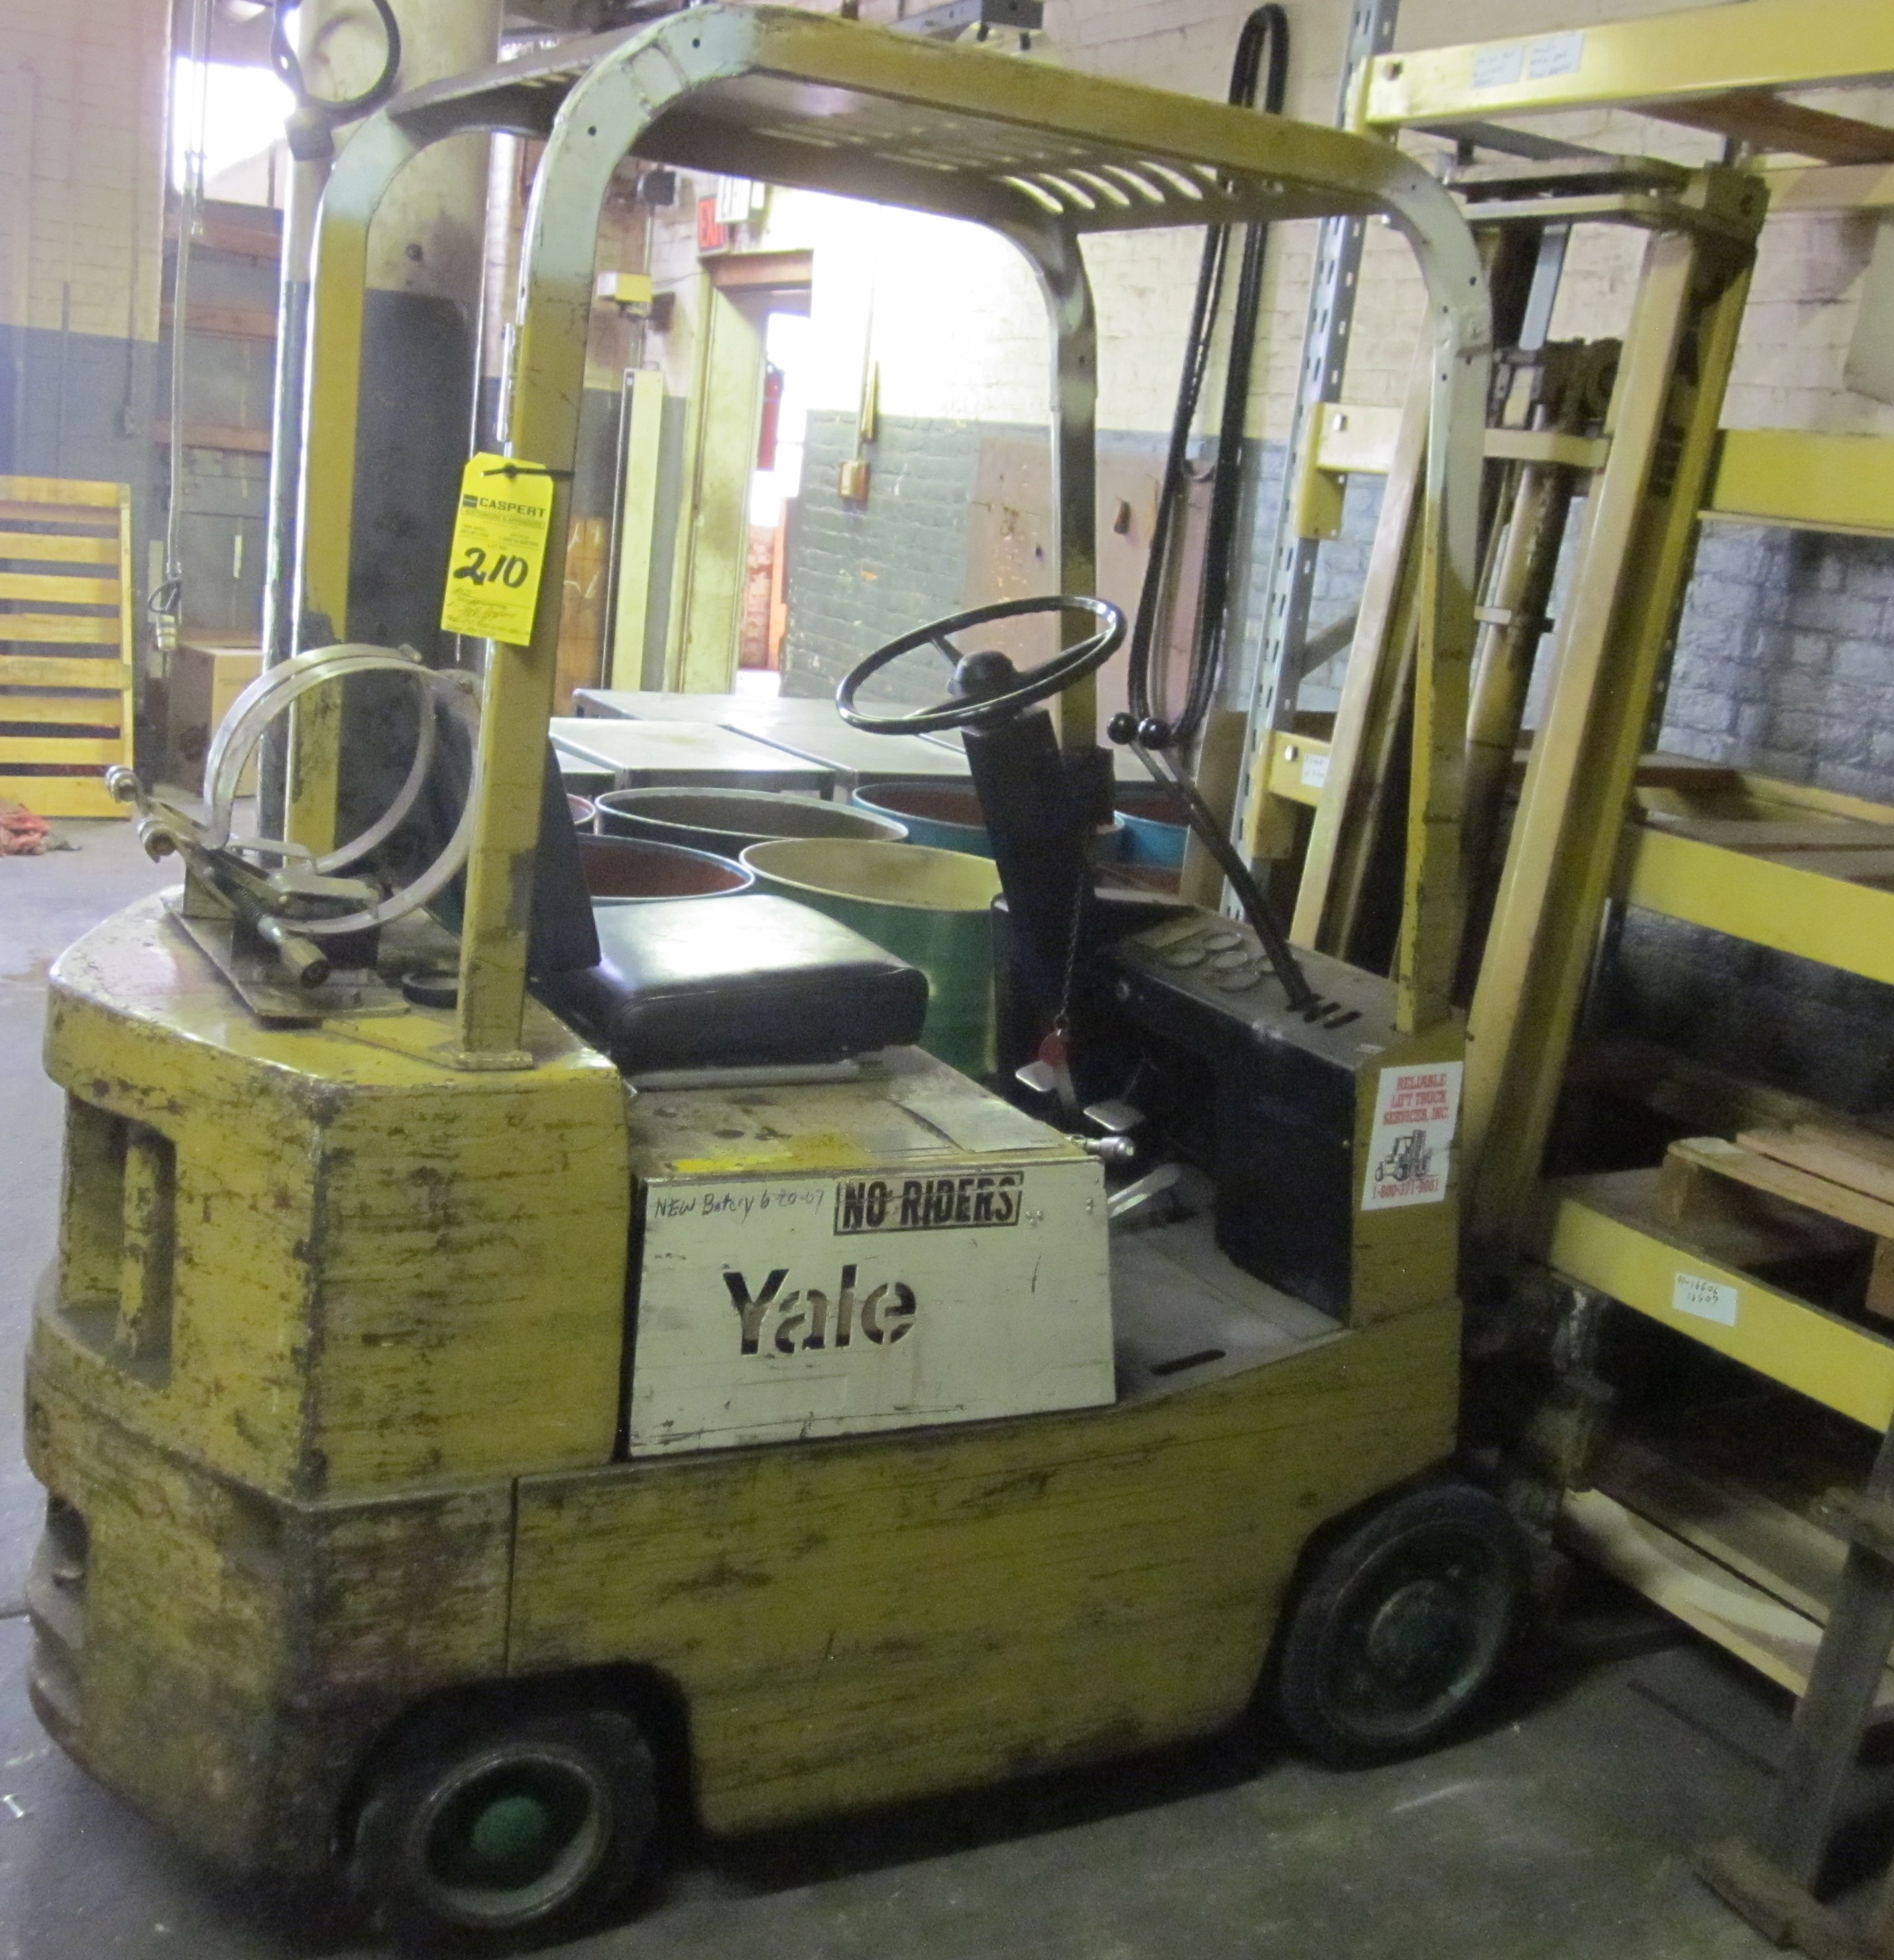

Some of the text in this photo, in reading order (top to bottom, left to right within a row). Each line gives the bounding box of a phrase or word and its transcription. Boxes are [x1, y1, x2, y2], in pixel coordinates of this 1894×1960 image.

[479, 498, 546, 517] CASPERT
[453, 548, 528, 588] 210
[1396, 1073, 1447, 1090] RELIABLE
[1391, 1090, 1447, 1108] LIFT TRUCK
[655, 1196, 695, 1219] NEW
[843, 1177, 1017, 1229] NO RIDERS
[723, 1264, 917, 1354] Yale
